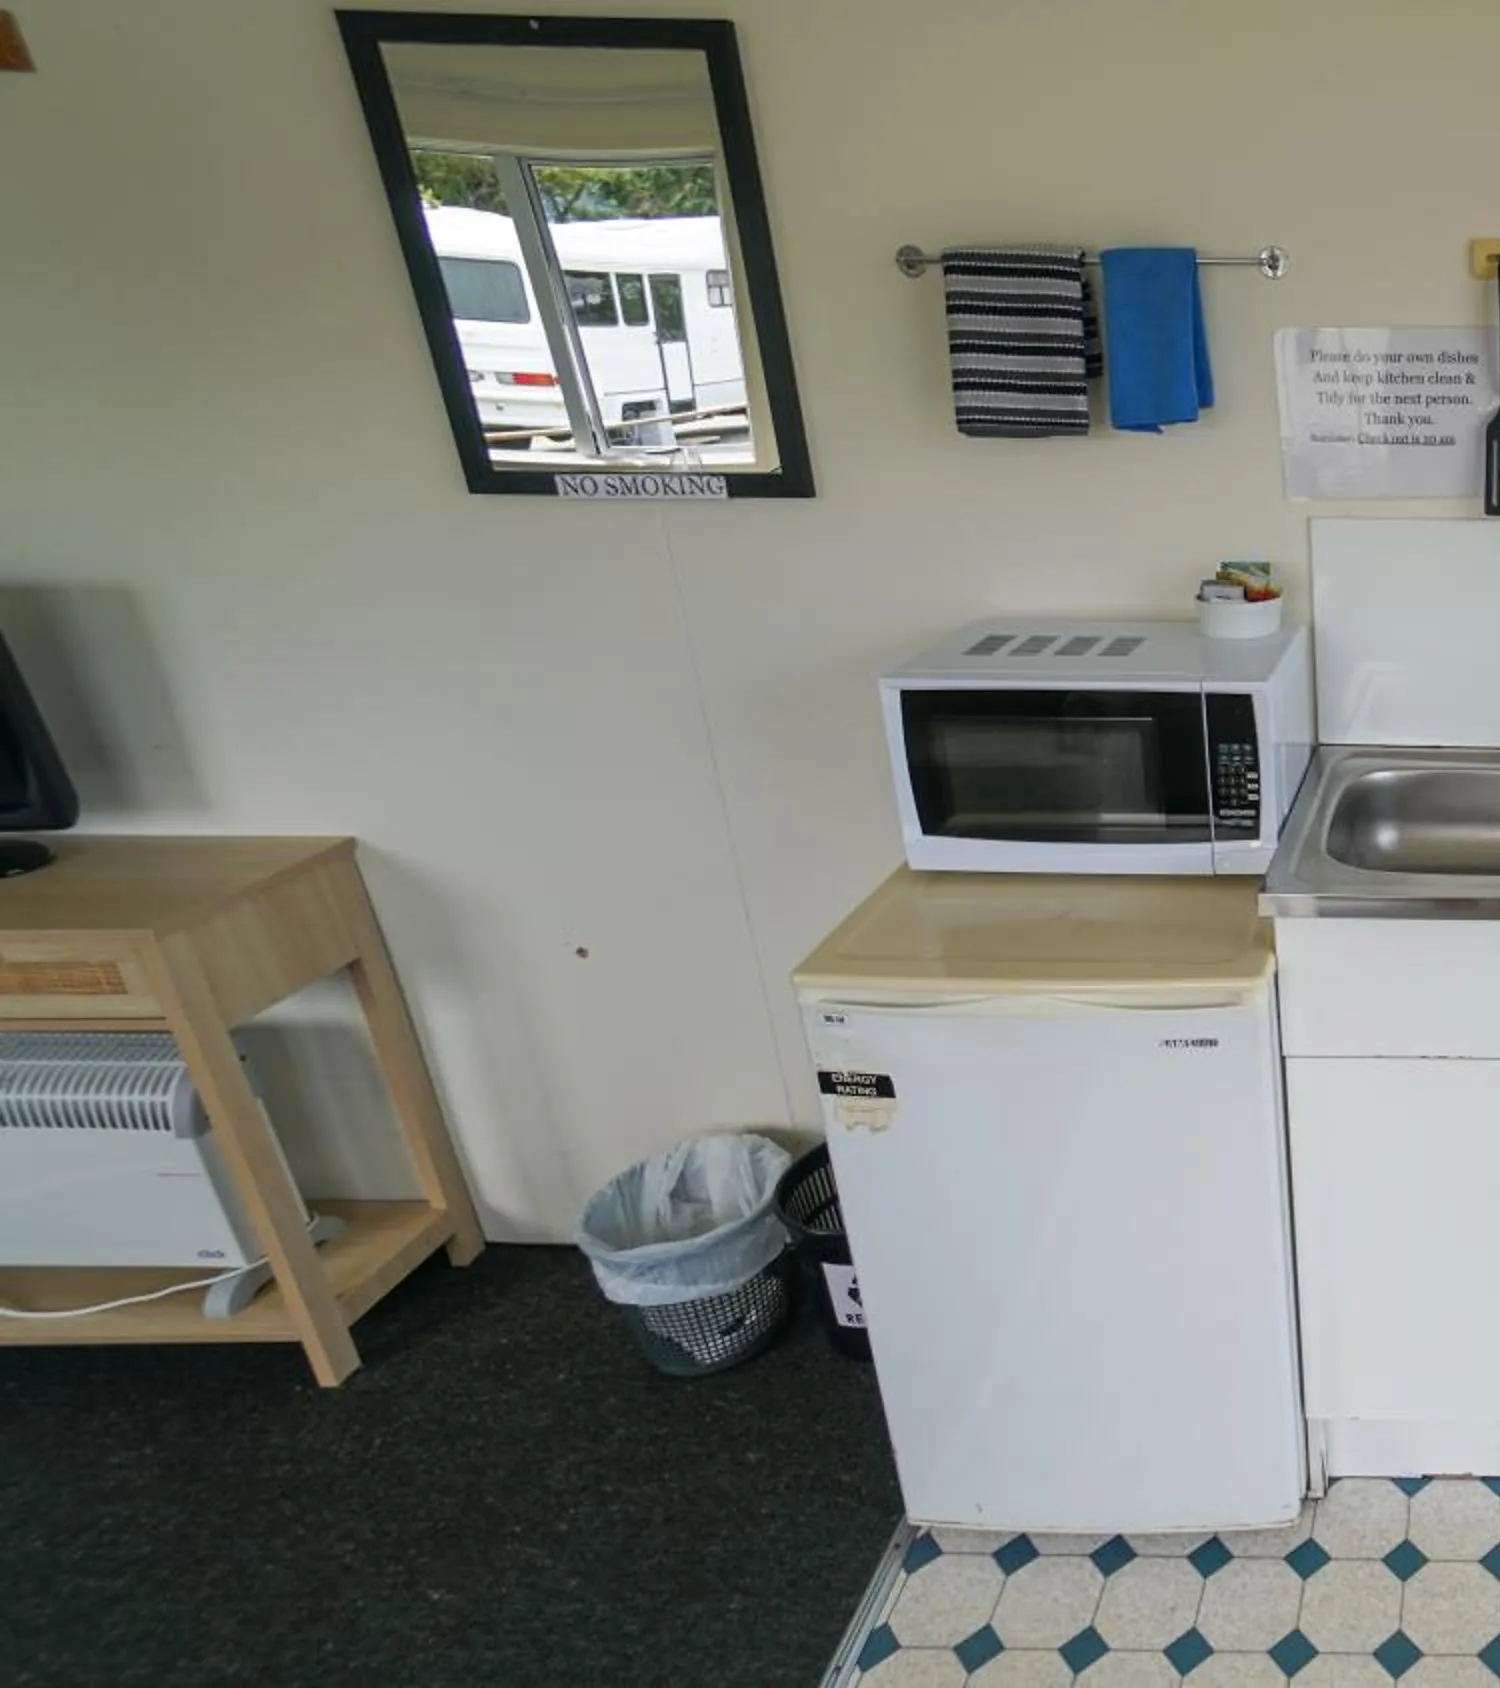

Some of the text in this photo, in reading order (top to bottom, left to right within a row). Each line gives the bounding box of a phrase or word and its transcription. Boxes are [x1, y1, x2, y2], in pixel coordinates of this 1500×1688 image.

[1310, 349, 1479, 366] Please do your own dishes
[1313, 371, 1476, 387] And keep kitchen clean &
[1316, 391, 1473, 408] Tidy for the next person.
[1365, 412, 1404, 425] Thank
[560, 475, 726, 497] NO SMOKING
[831, 1072, 877, 1085] ENERGY
[836, 1085, 878, 1096] RATING
